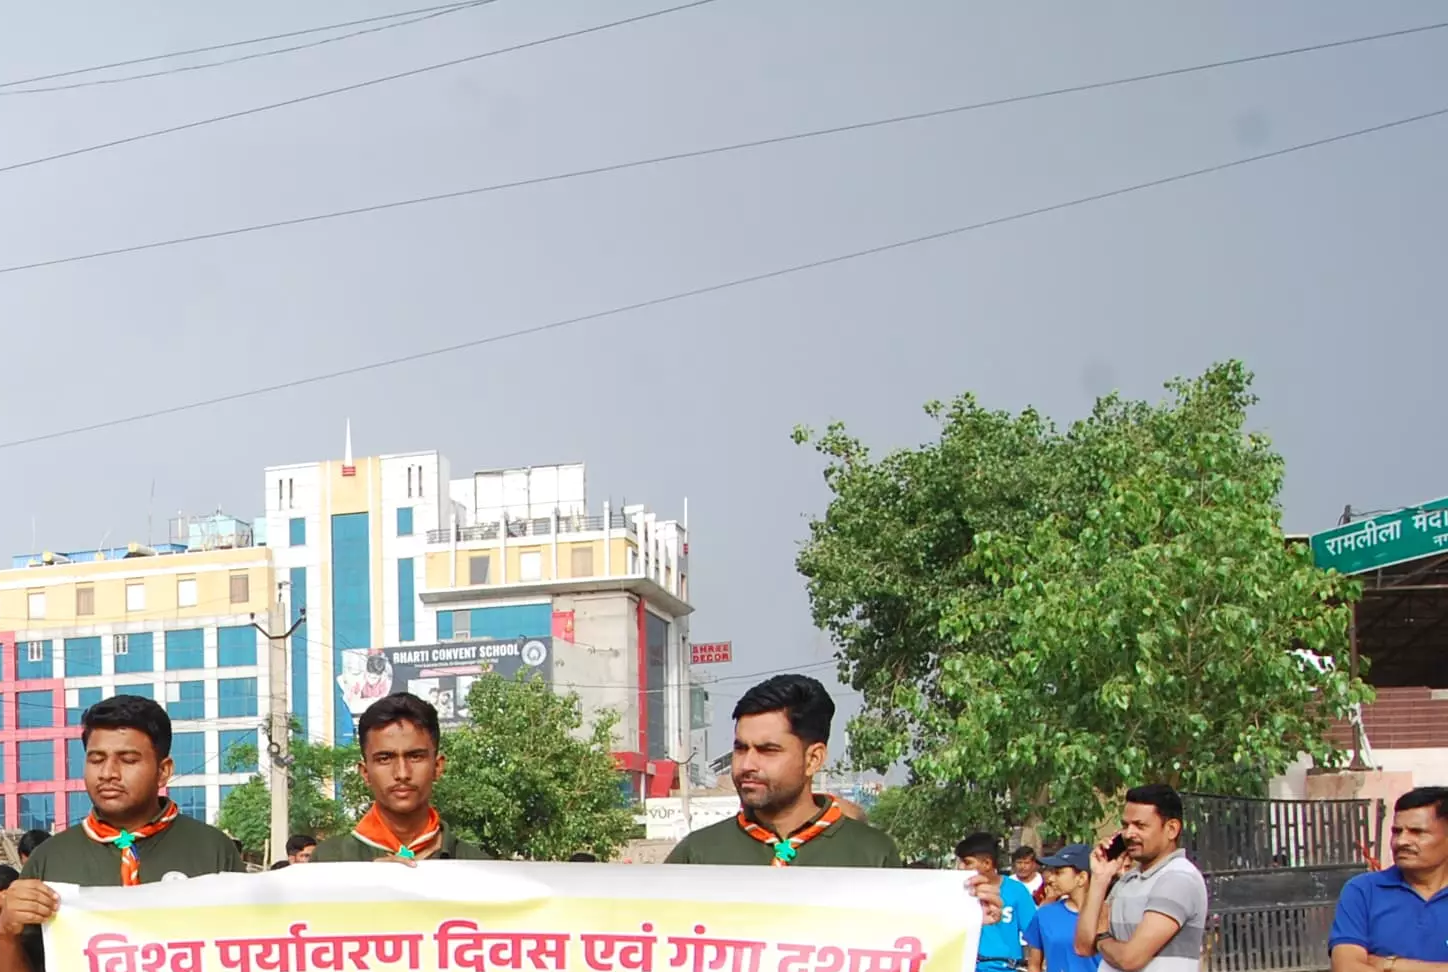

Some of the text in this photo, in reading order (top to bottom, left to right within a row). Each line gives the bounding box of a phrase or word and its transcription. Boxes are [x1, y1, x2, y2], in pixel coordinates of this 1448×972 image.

[1324, 518, 1403, 557] रामलीला
[393, 650, 430, 664] BHARTI
[432, 646, 477, 662] CONVENT
[479, 643, 520, 658] SCHOOL
[692, 653, 729, 664] DECOR
[433, 920, 571, 972] दिवस
[580, 922, 658, 972] एवं
